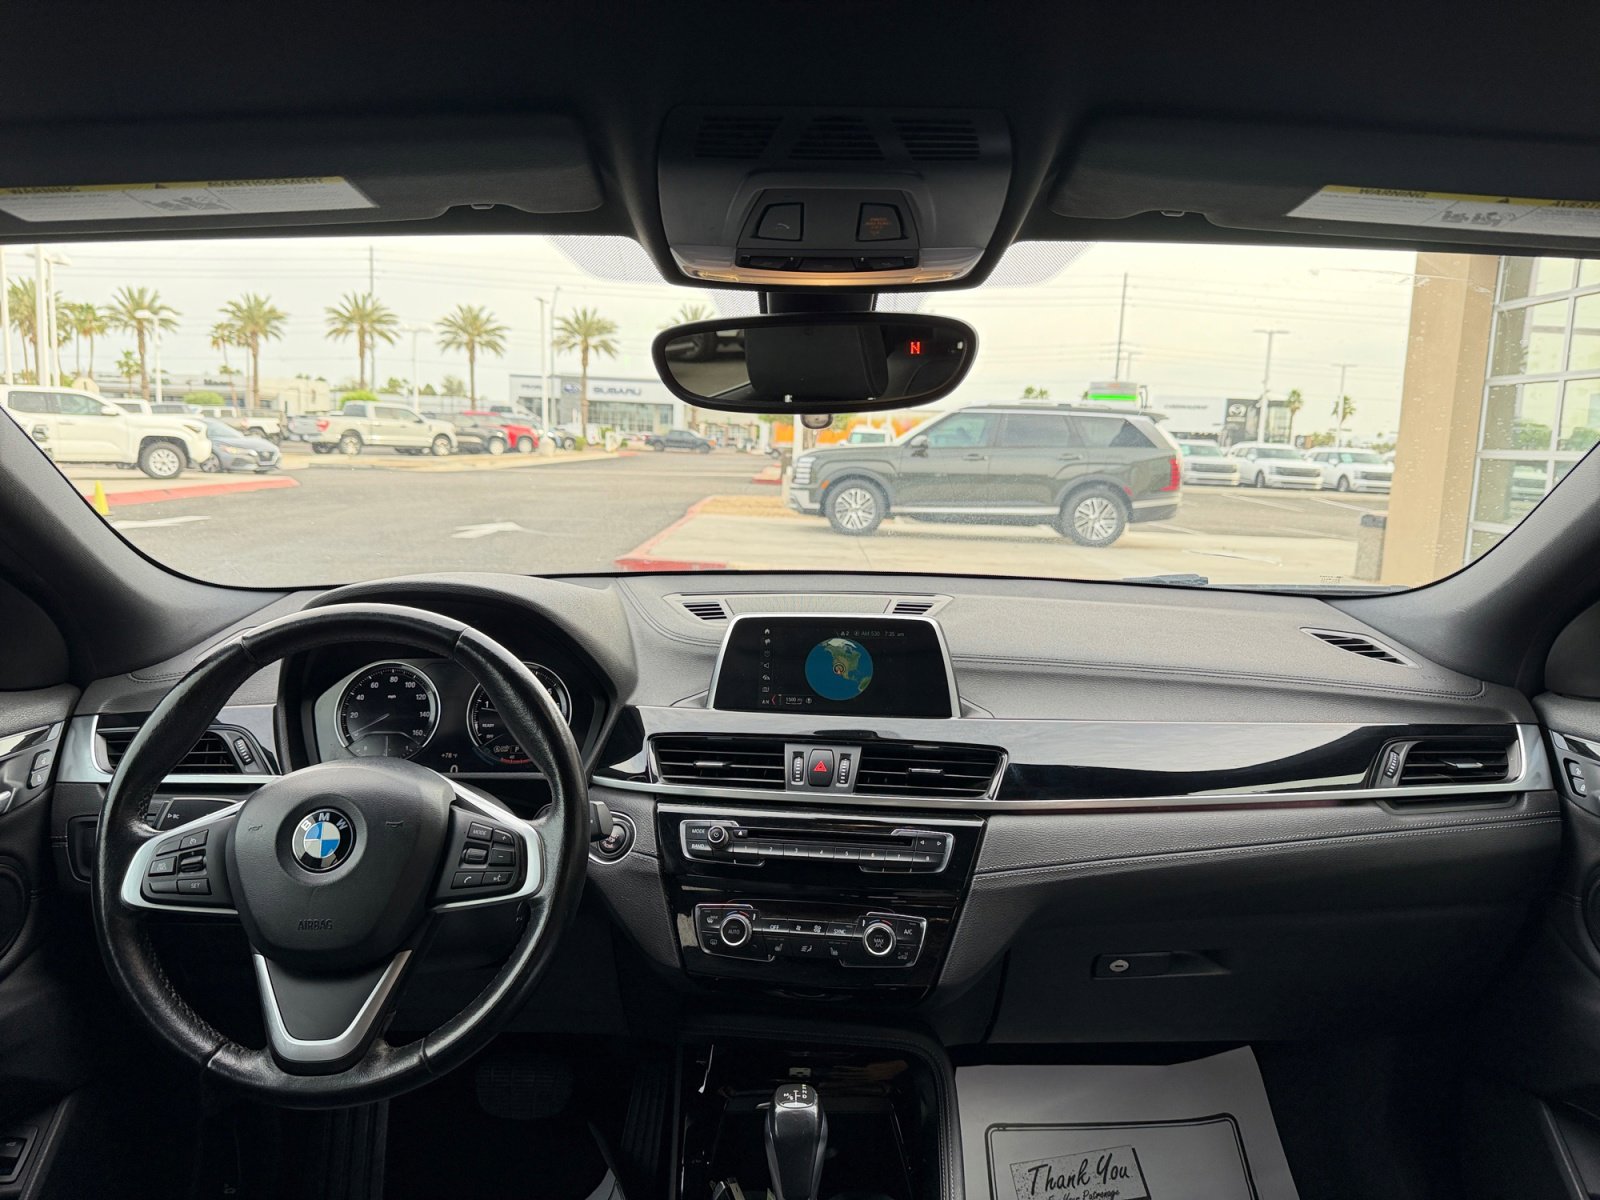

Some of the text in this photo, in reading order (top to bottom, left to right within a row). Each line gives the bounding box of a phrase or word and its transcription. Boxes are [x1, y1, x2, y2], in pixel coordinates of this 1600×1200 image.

[911, 341, 921, 355] N
[593, 386, 642, 397] SUBARU
[370, 681, 379, 689] 60
[404, 681, 416, 689] 100
[415, 693, 427, 701] 120
[350, 711, 359, 719] 20
[412, 729, 424, 737] 160
[301, 812, 348, 831] BMW
[298, 919, 333, 931] AIRBAG
[1028, 1153, 1130, 1196] Thank You
